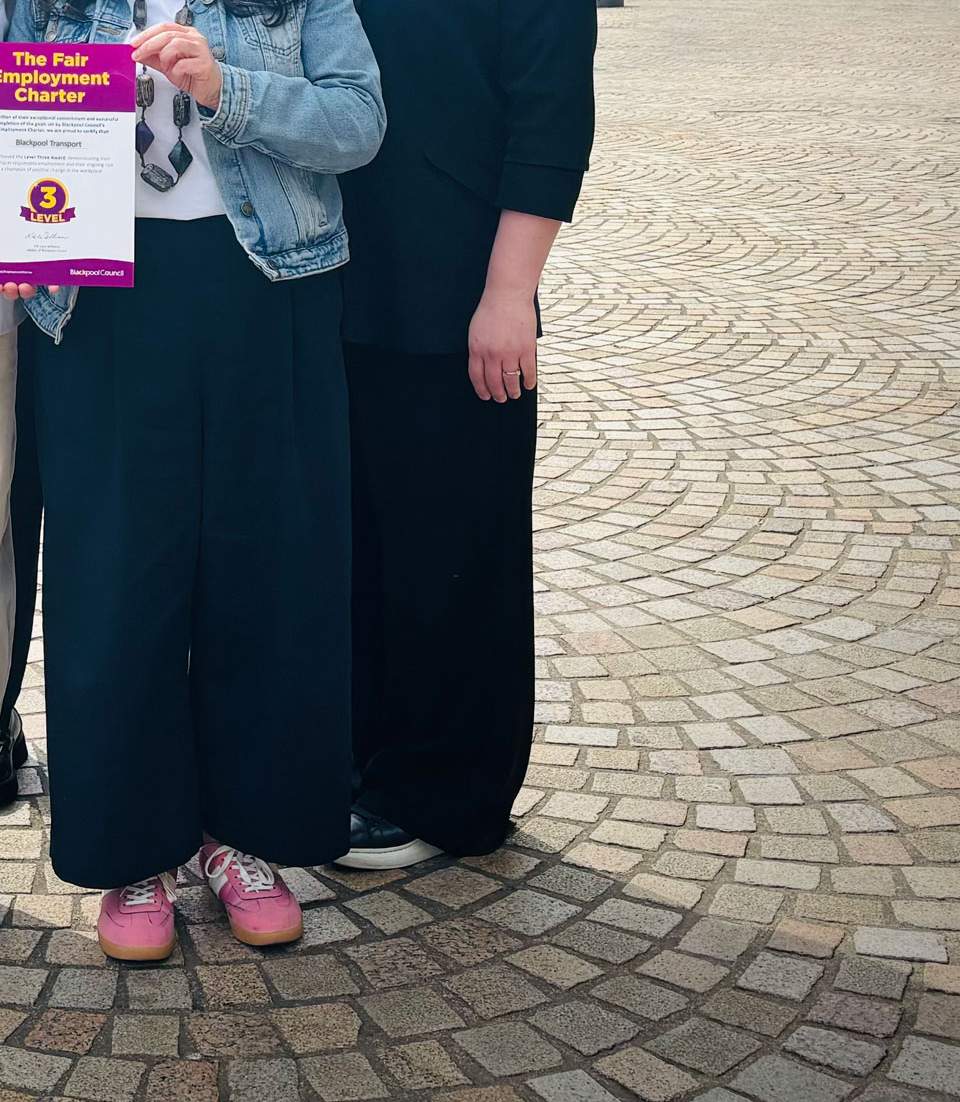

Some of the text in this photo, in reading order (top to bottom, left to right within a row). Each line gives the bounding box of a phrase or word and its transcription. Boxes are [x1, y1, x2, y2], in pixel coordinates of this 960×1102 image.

[13, 51, 88, 67] The Fair
[14, 88, 86, 103] Charter
[15, 139, 82, 148] Blackpool Transport
[39, 186, 57, 209] 3
[30, 212, 65, 223] LEVEL
